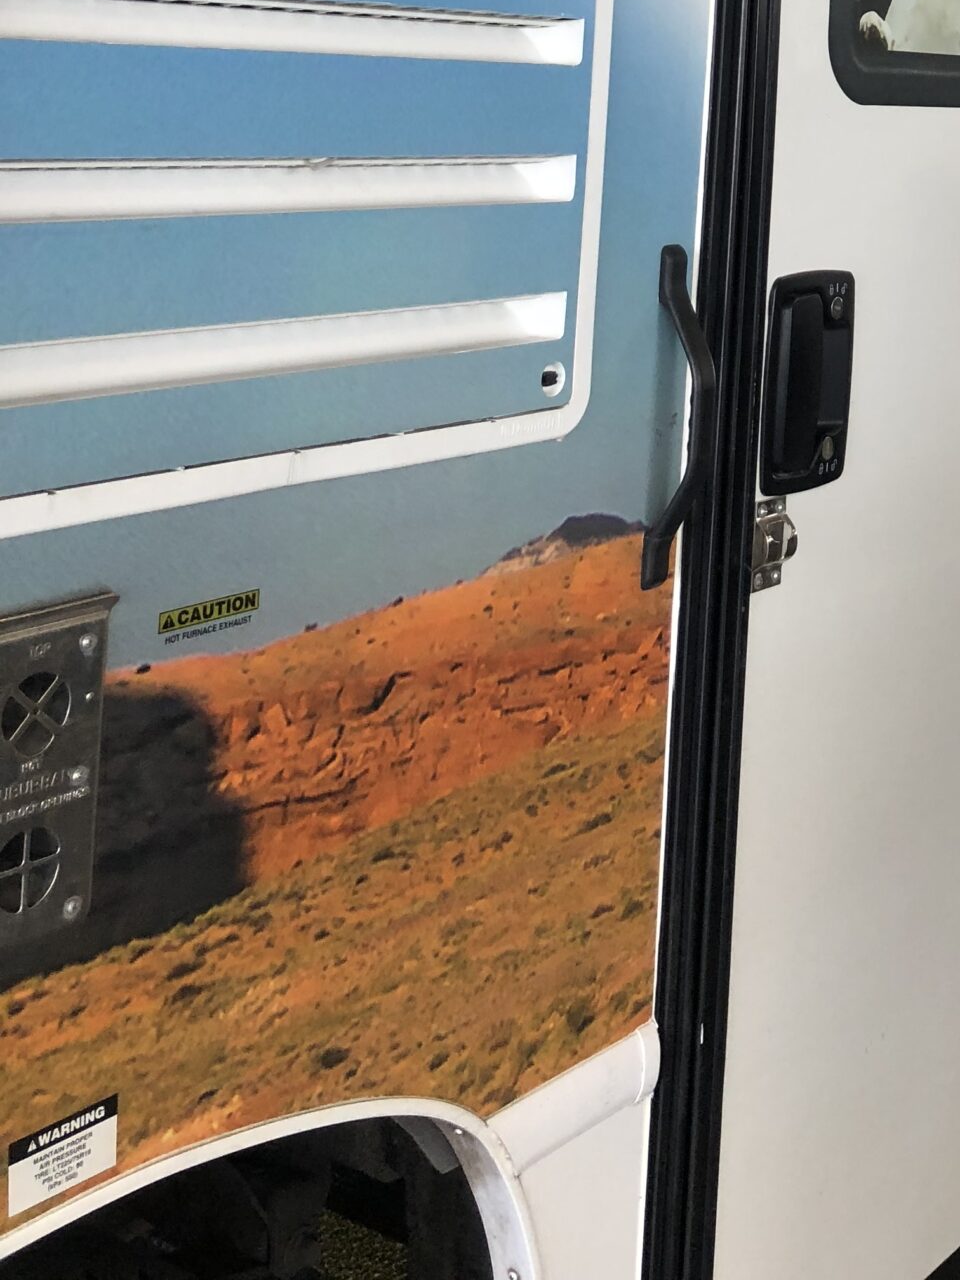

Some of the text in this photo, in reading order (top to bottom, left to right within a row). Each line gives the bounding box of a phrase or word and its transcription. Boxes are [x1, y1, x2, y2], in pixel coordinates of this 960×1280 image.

[176, 592, 257, 625] CAUTION
[164, 615, 252, 645] HOT FURNACE EXHAUST
[38, 1105, 106, 1146] WARNING
[33, 1131, 93, 1165] MAINTAIN PROPER
[39, 1143, 87, 1170] AIR PRESSURE
